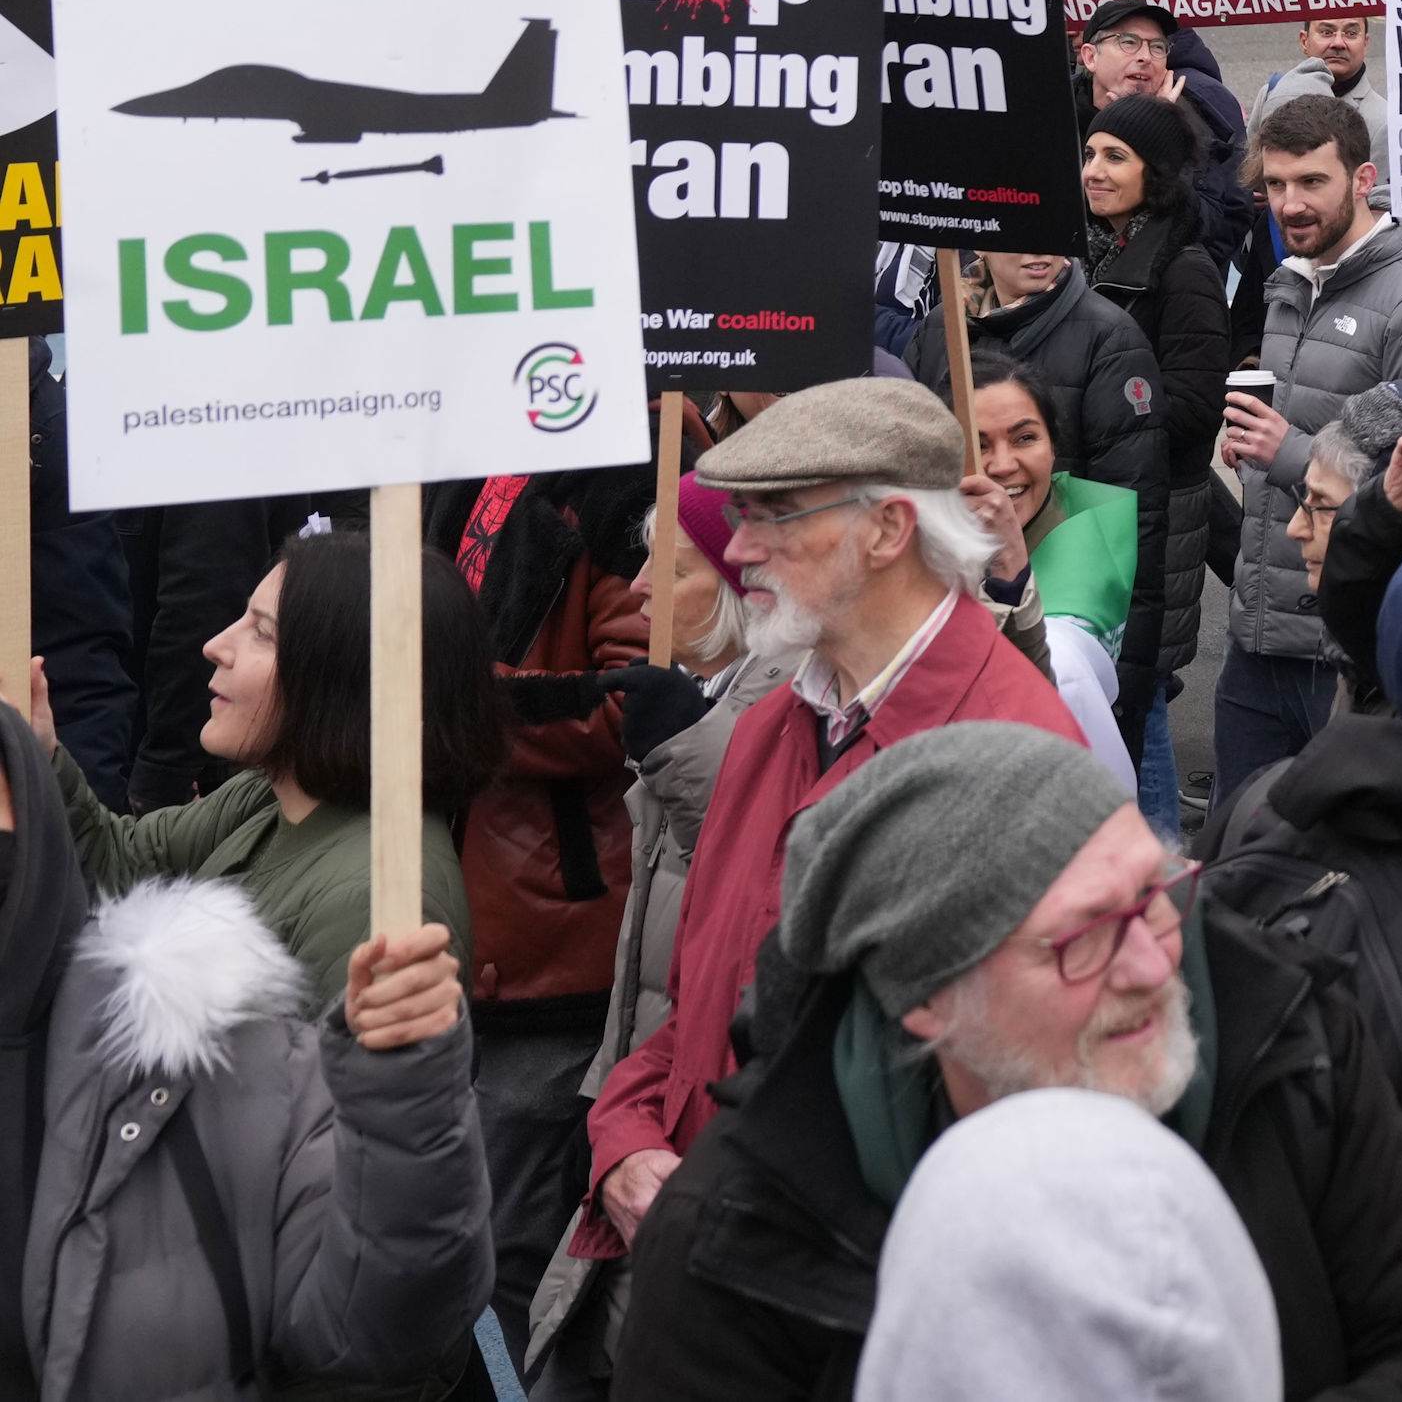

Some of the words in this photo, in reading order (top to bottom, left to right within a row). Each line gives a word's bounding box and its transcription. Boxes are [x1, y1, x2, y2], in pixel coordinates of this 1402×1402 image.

[624, 36, 859, 127] mbing
[881, 41, 1008, 112] ran
[880, 210, 1000, 233] www.stopwar.org.uk
[903, 180, 929, 197] the
[930, 182, 965, 199] War
[967, 188, 1040, 205] coalition
[116, 219, 596, 336] ISRAEL
[666, 309, 714, 329] War
[717, 311, 815, 330] coalition
[122, 389, 443, 434] palestinecampaign.org
[529, 373, 583, 405] PSC
